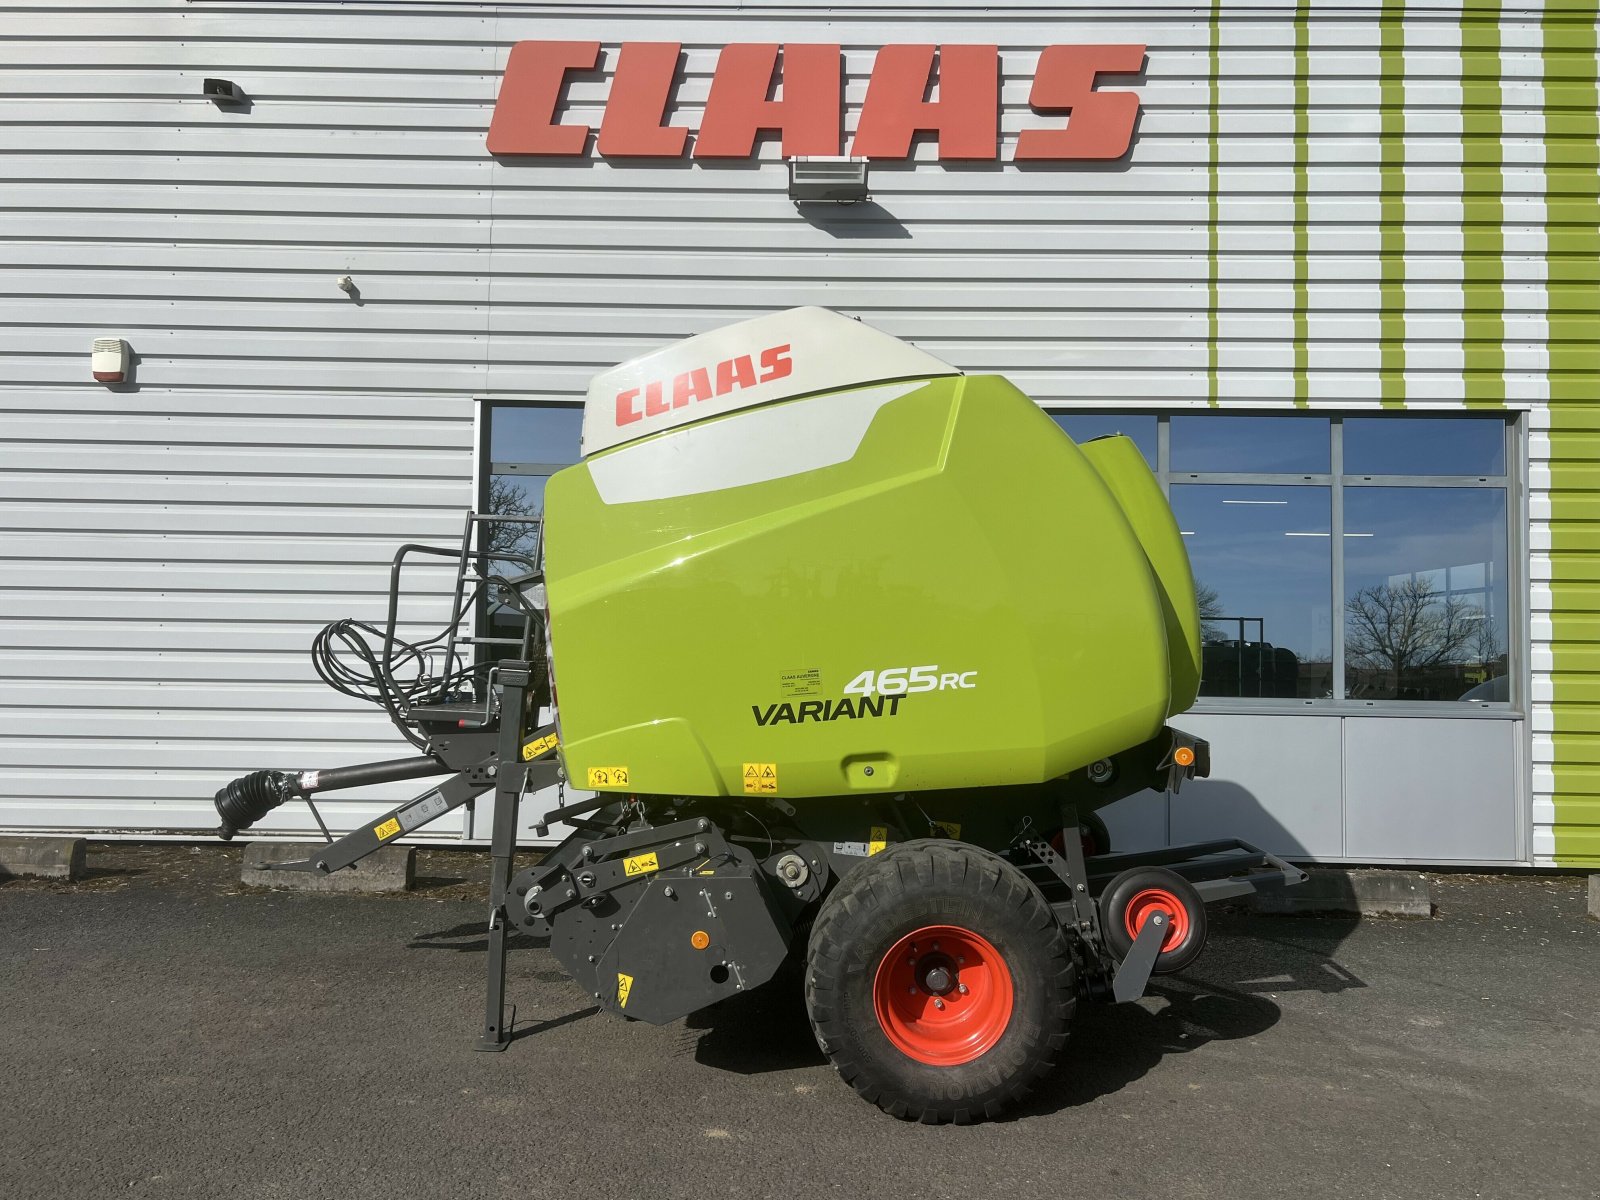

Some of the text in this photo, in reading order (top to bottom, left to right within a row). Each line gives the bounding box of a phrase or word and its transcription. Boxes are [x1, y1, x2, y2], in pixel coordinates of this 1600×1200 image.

[486, 40, 1146, 161] CLAAS
[615, 343, 793, 427] CLAAS
[752, 694, 907, 727] VARIANT
